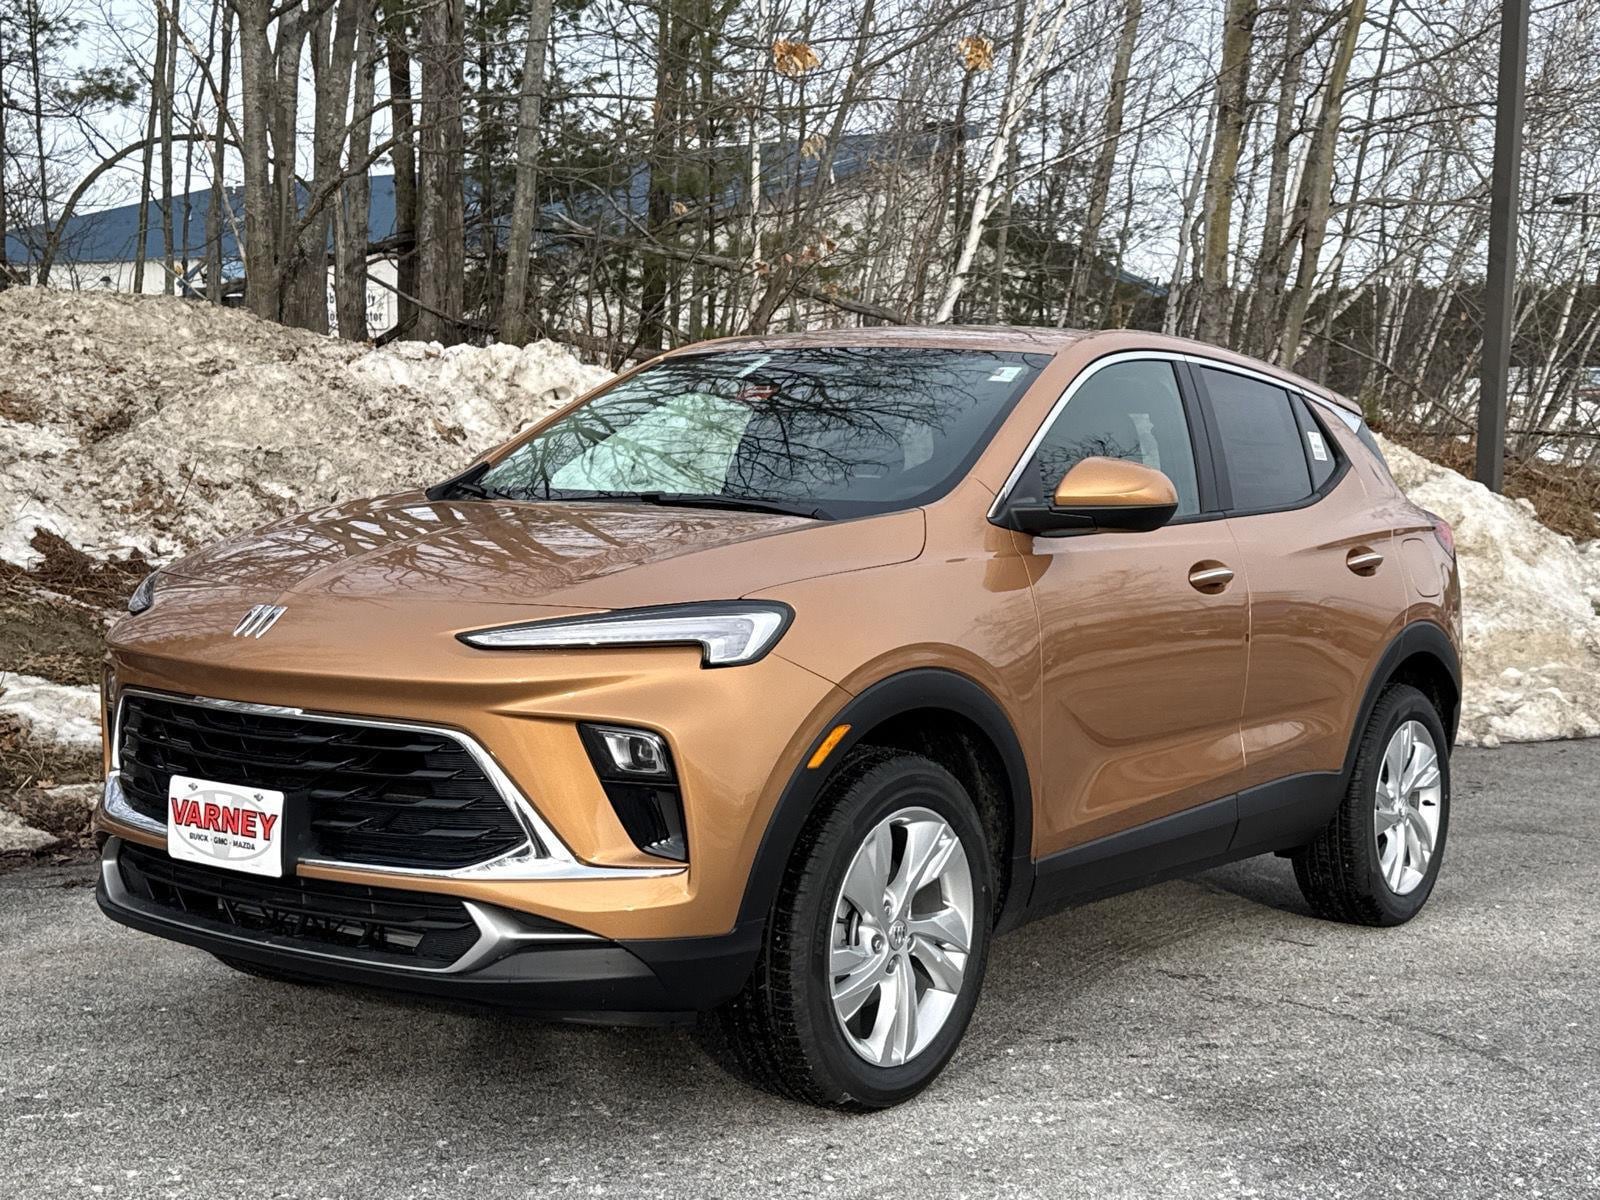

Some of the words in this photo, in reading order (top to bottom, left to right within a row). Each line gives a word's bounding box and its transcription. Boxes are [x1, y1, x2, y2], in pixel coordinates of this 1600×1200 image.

[171, 797, 278, 841] VARNEY
[189, 832, 209, 842] BUICK
[213, 836, 228, 846] GMC
[232, 840, 256, 850] MAZDA
